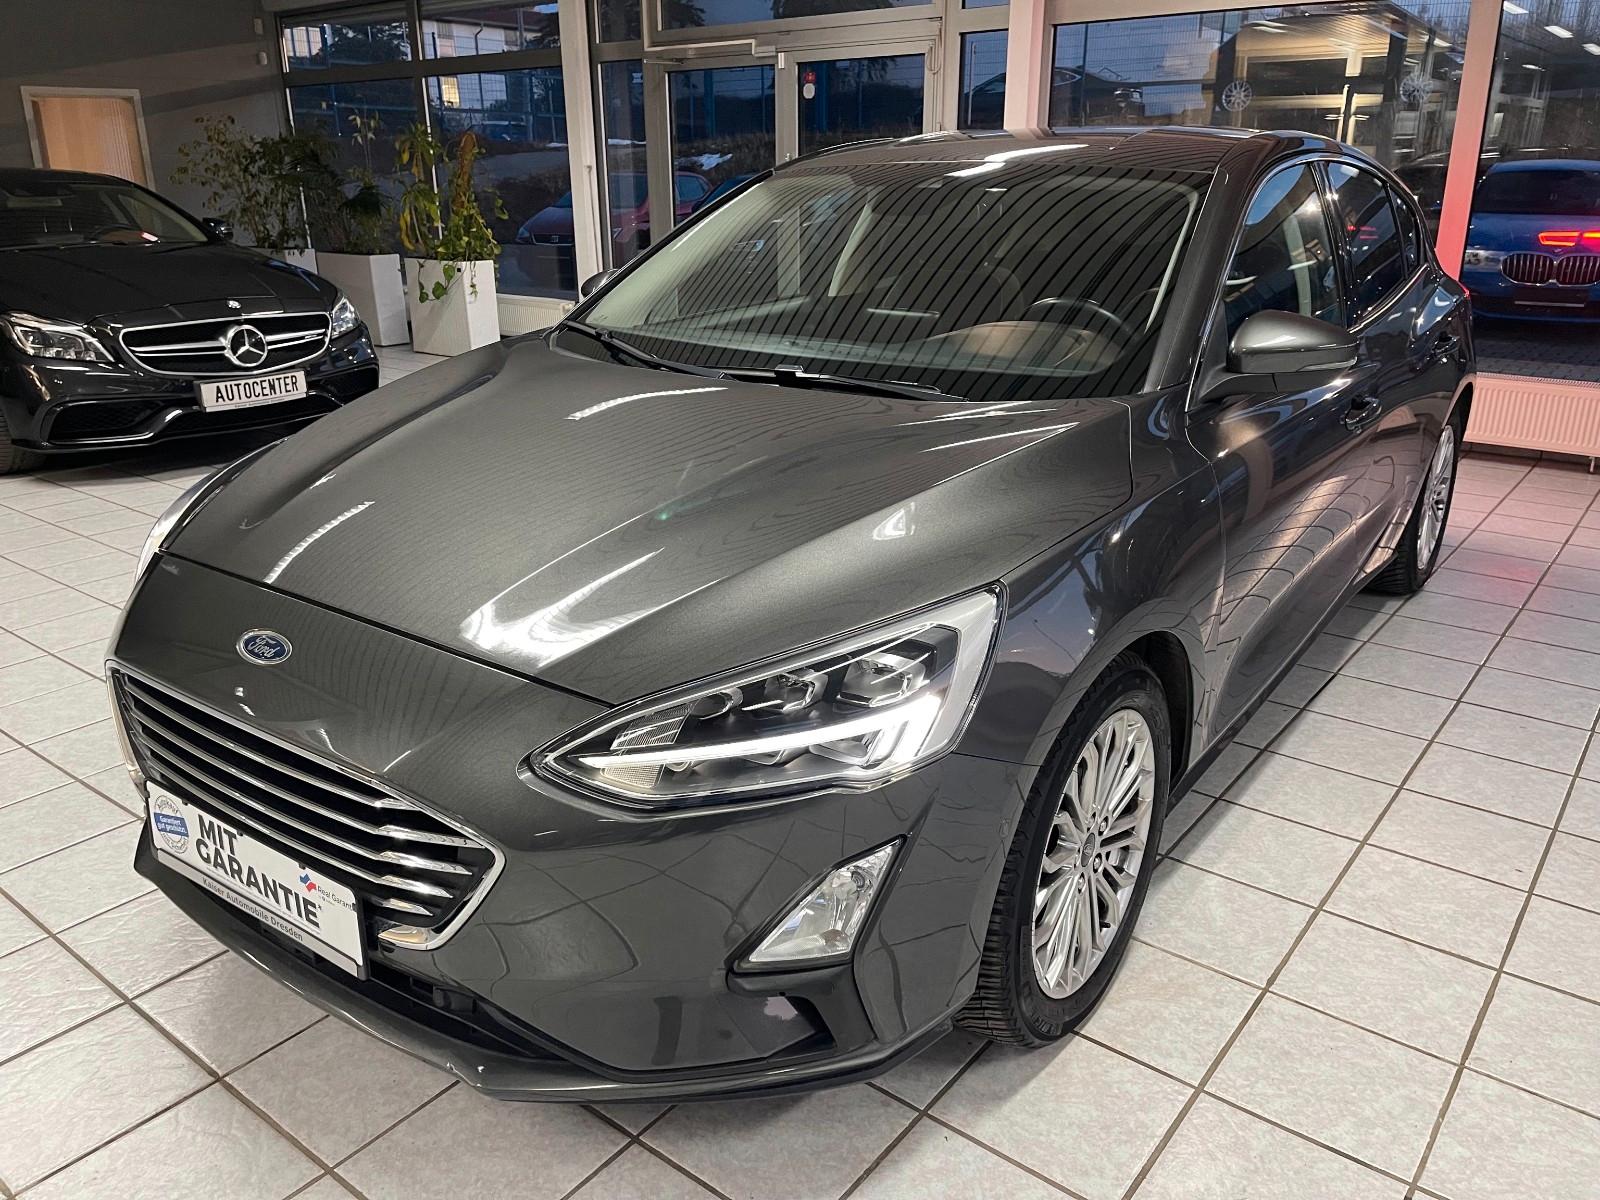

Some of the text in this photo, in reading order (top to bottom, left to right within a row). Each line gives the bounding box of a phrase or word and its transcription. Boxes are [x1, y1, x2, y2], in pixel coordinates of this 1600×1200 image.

[215, 375, 299, 403] AUTOCENTER
[247, 635, 280, 658] Ford
[198, 814, 238, 856] MIT
[202, 876, 303, 941] Kaiser Automobile Dresden
